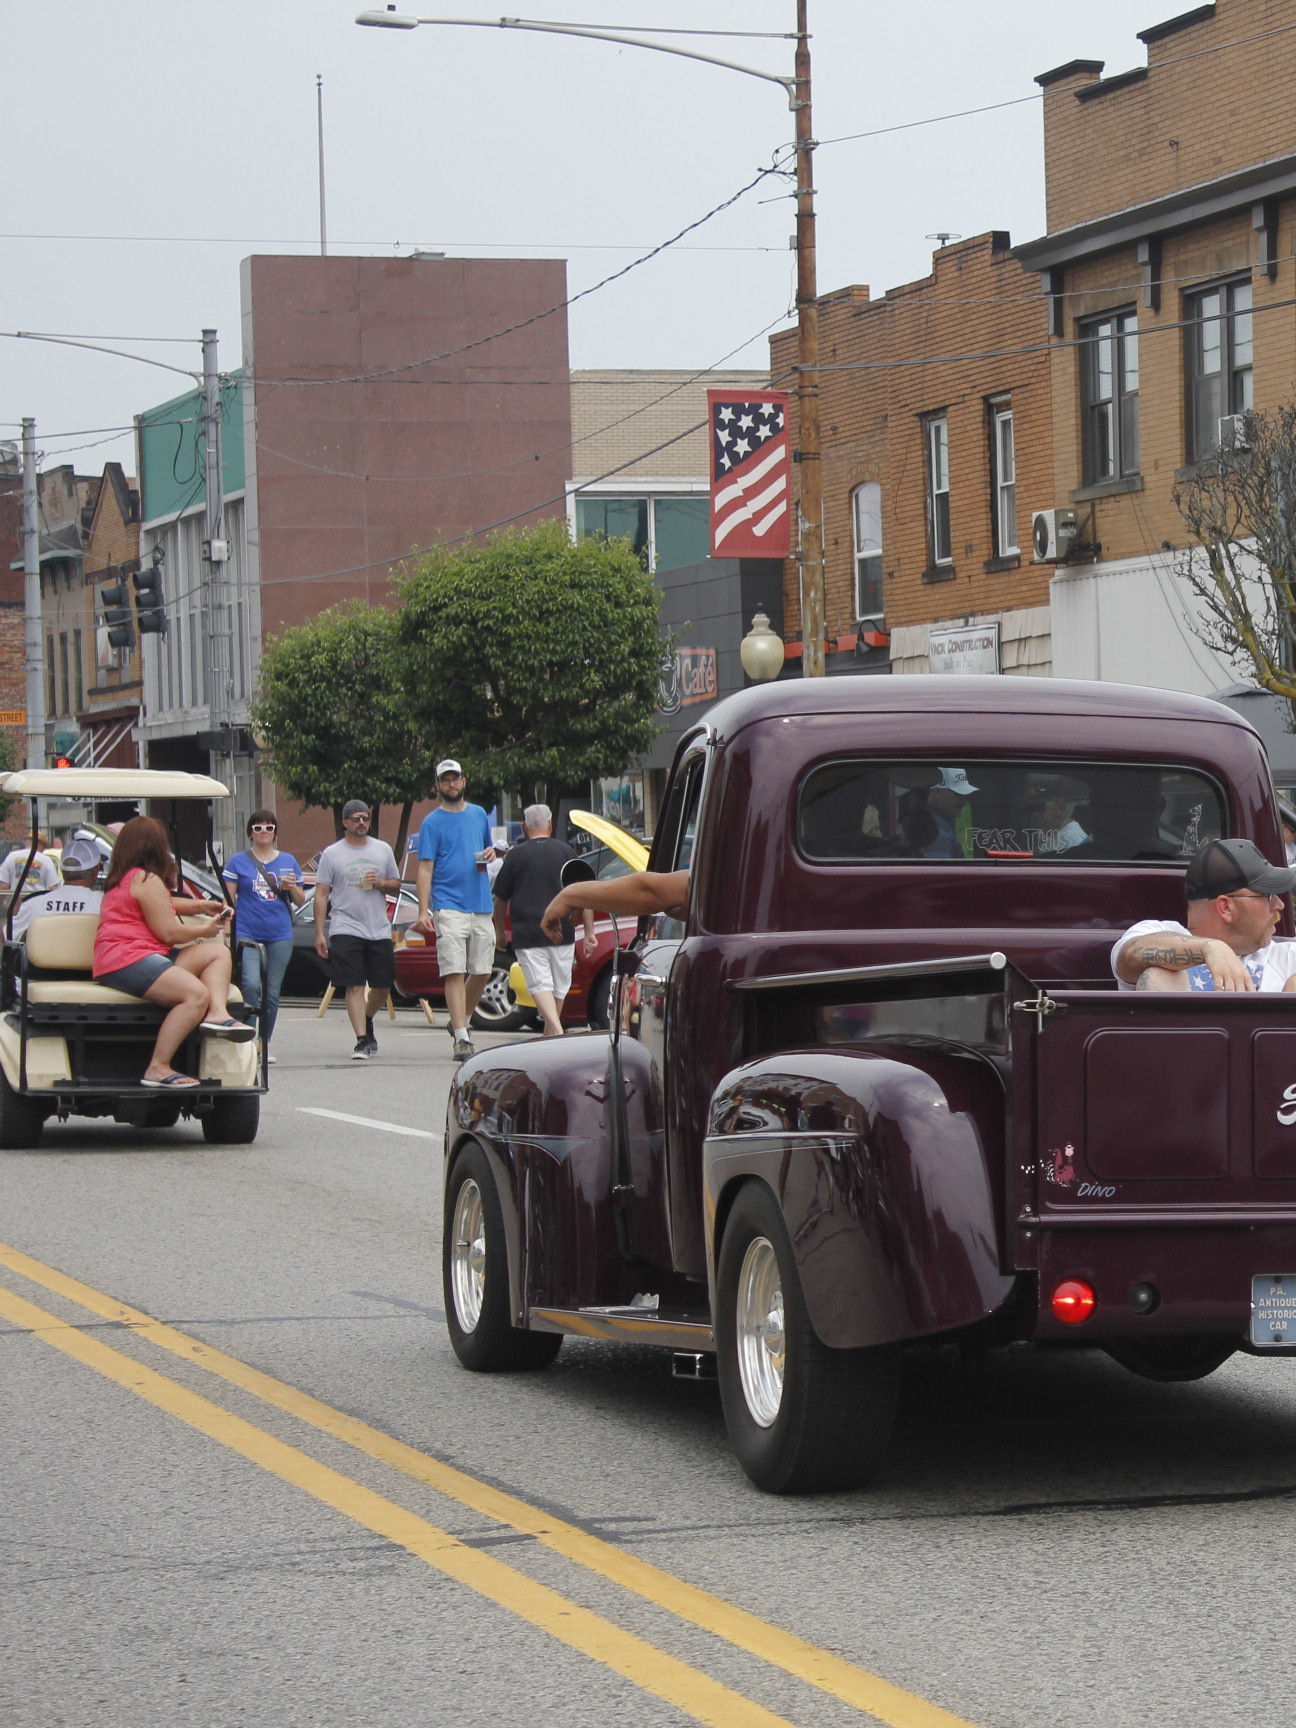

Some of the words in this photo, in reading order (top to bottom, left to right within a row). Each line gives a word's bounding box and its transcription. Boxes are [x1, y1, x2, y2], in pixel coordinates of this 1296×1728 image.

[681, 655, 714, 695] Café
[965, 827, 1022, 852] FEAR
[1022, 827, 1074, 854] THIS
[46, 901, 86, 912] STAFF
[1269, 1321, 1288, 1331] CAR
